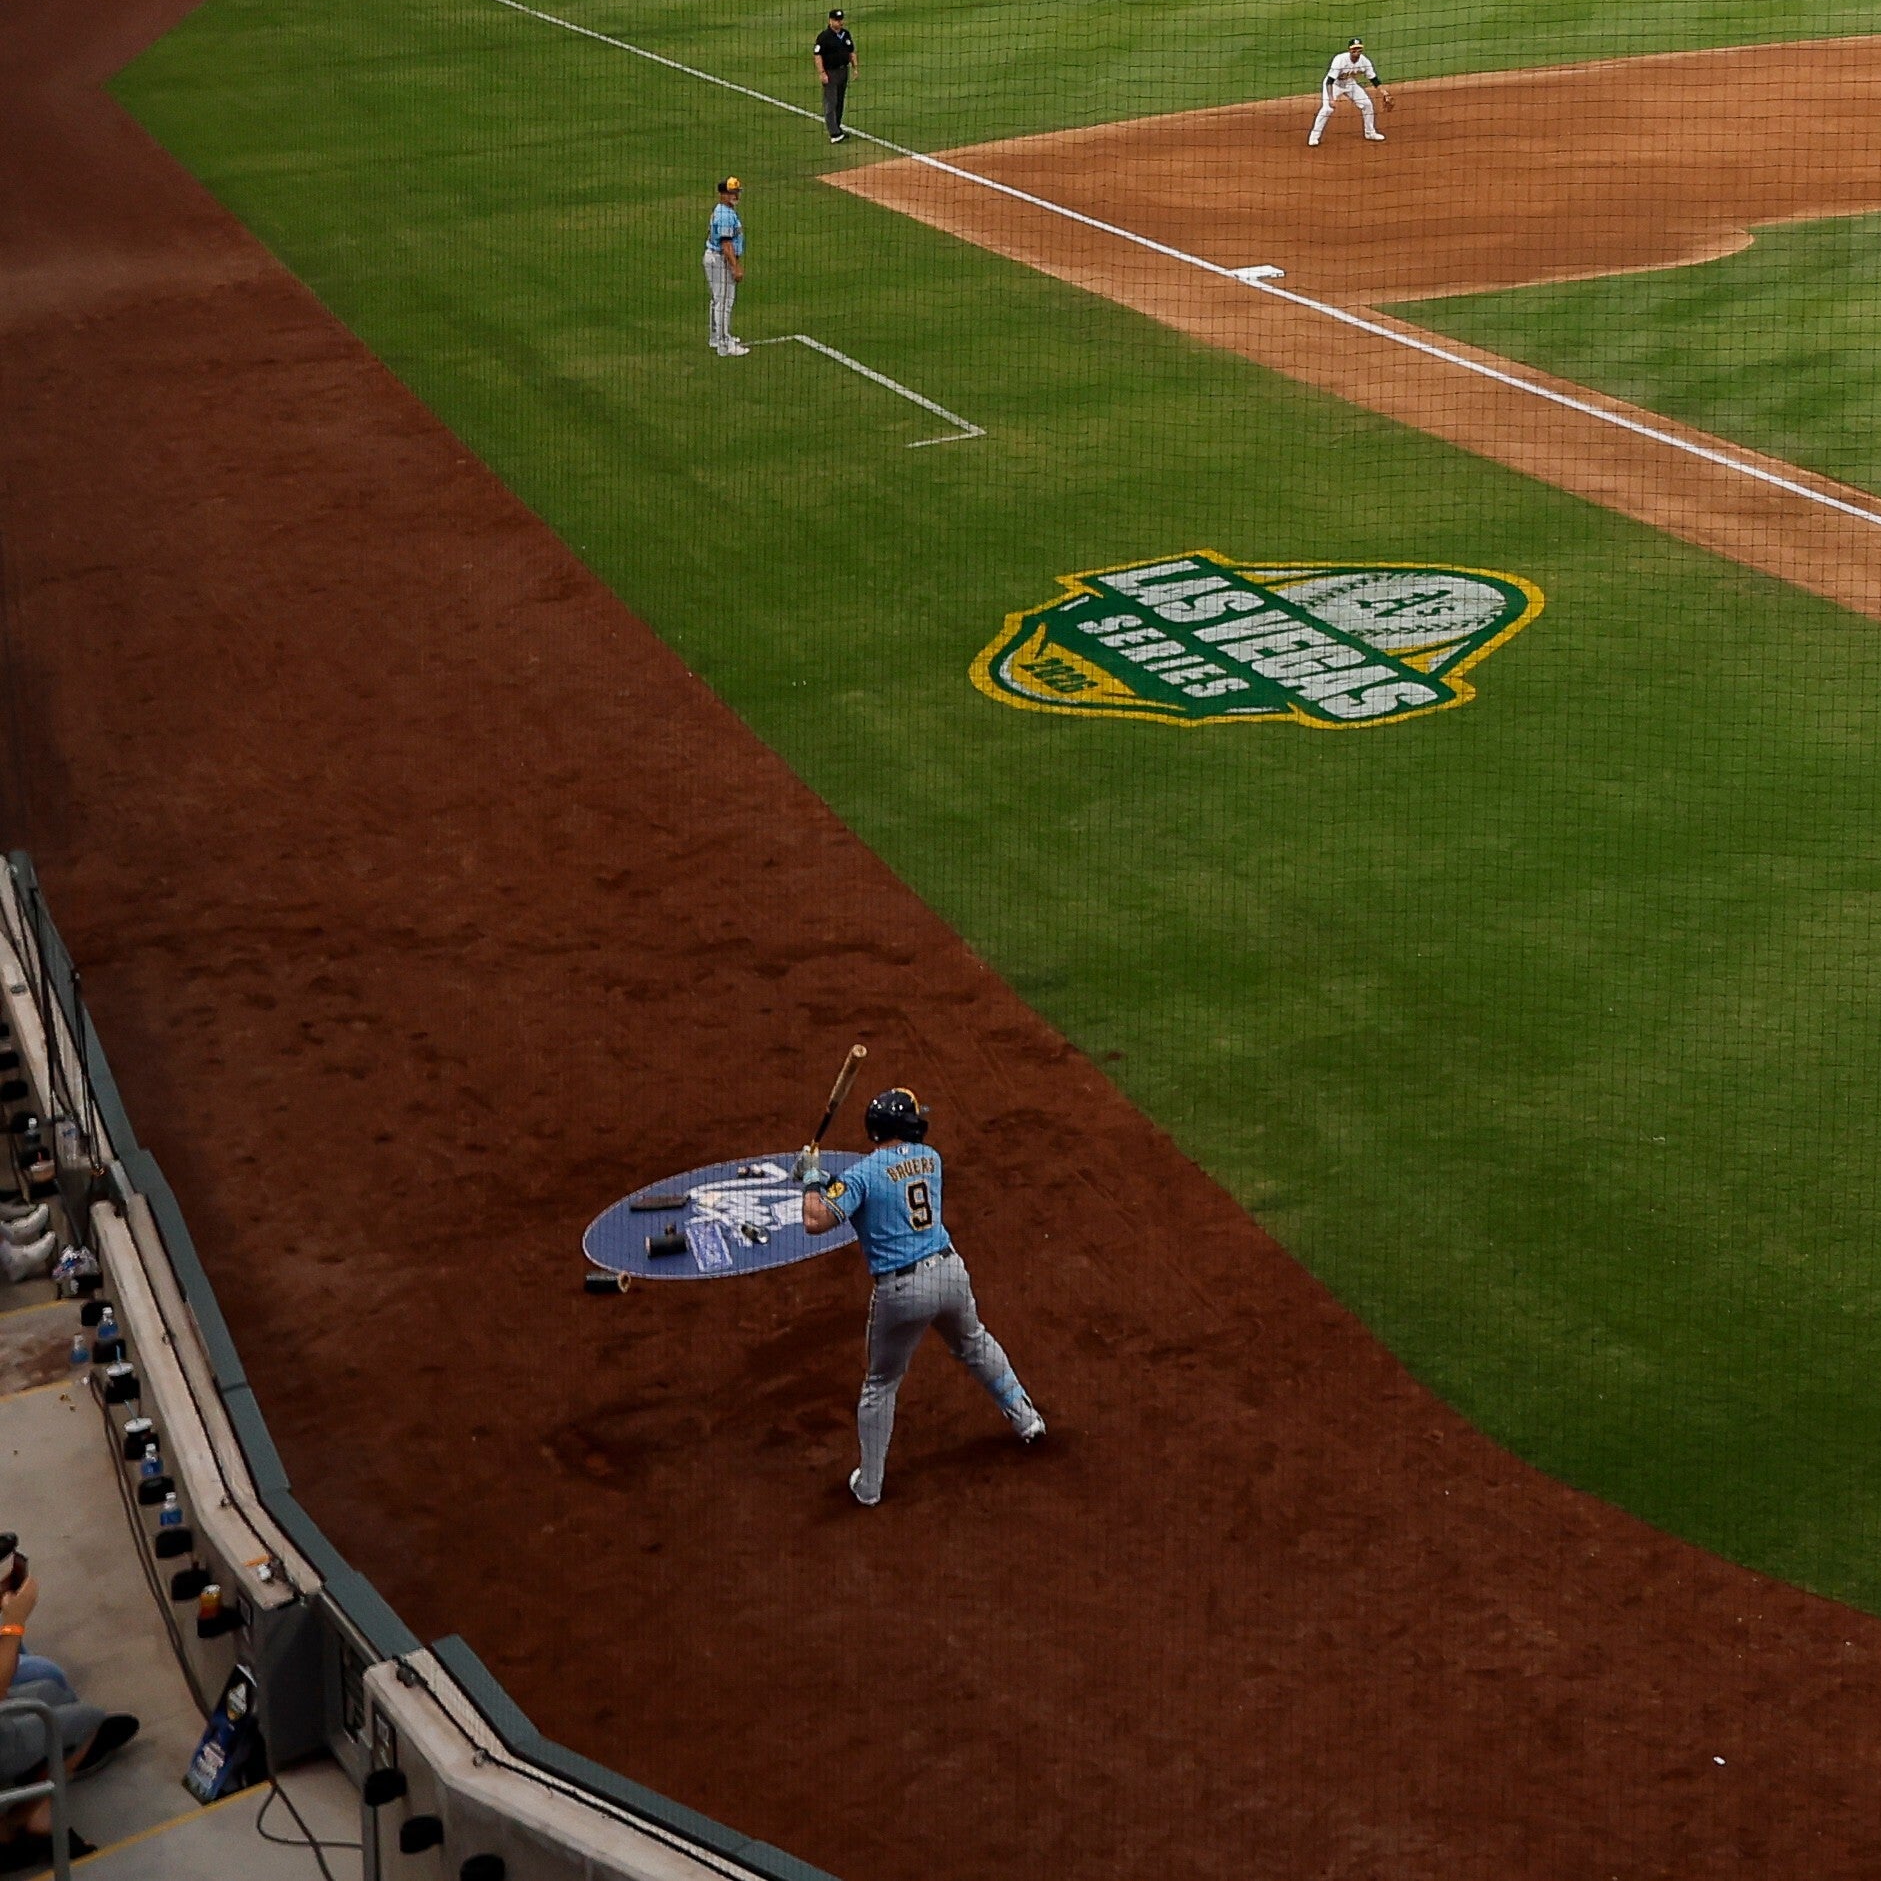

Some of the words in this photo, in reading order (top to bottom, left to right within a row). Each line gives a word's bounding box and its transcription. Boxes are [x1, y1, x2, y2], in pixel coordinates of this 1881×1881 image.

[1077, 614, 1250, 700] SERIES
[1098, 559, 1267, 622] LAS
[1192, 608, 1438, 719] VEGAS
[907, 1179, 934, 1232] 9
